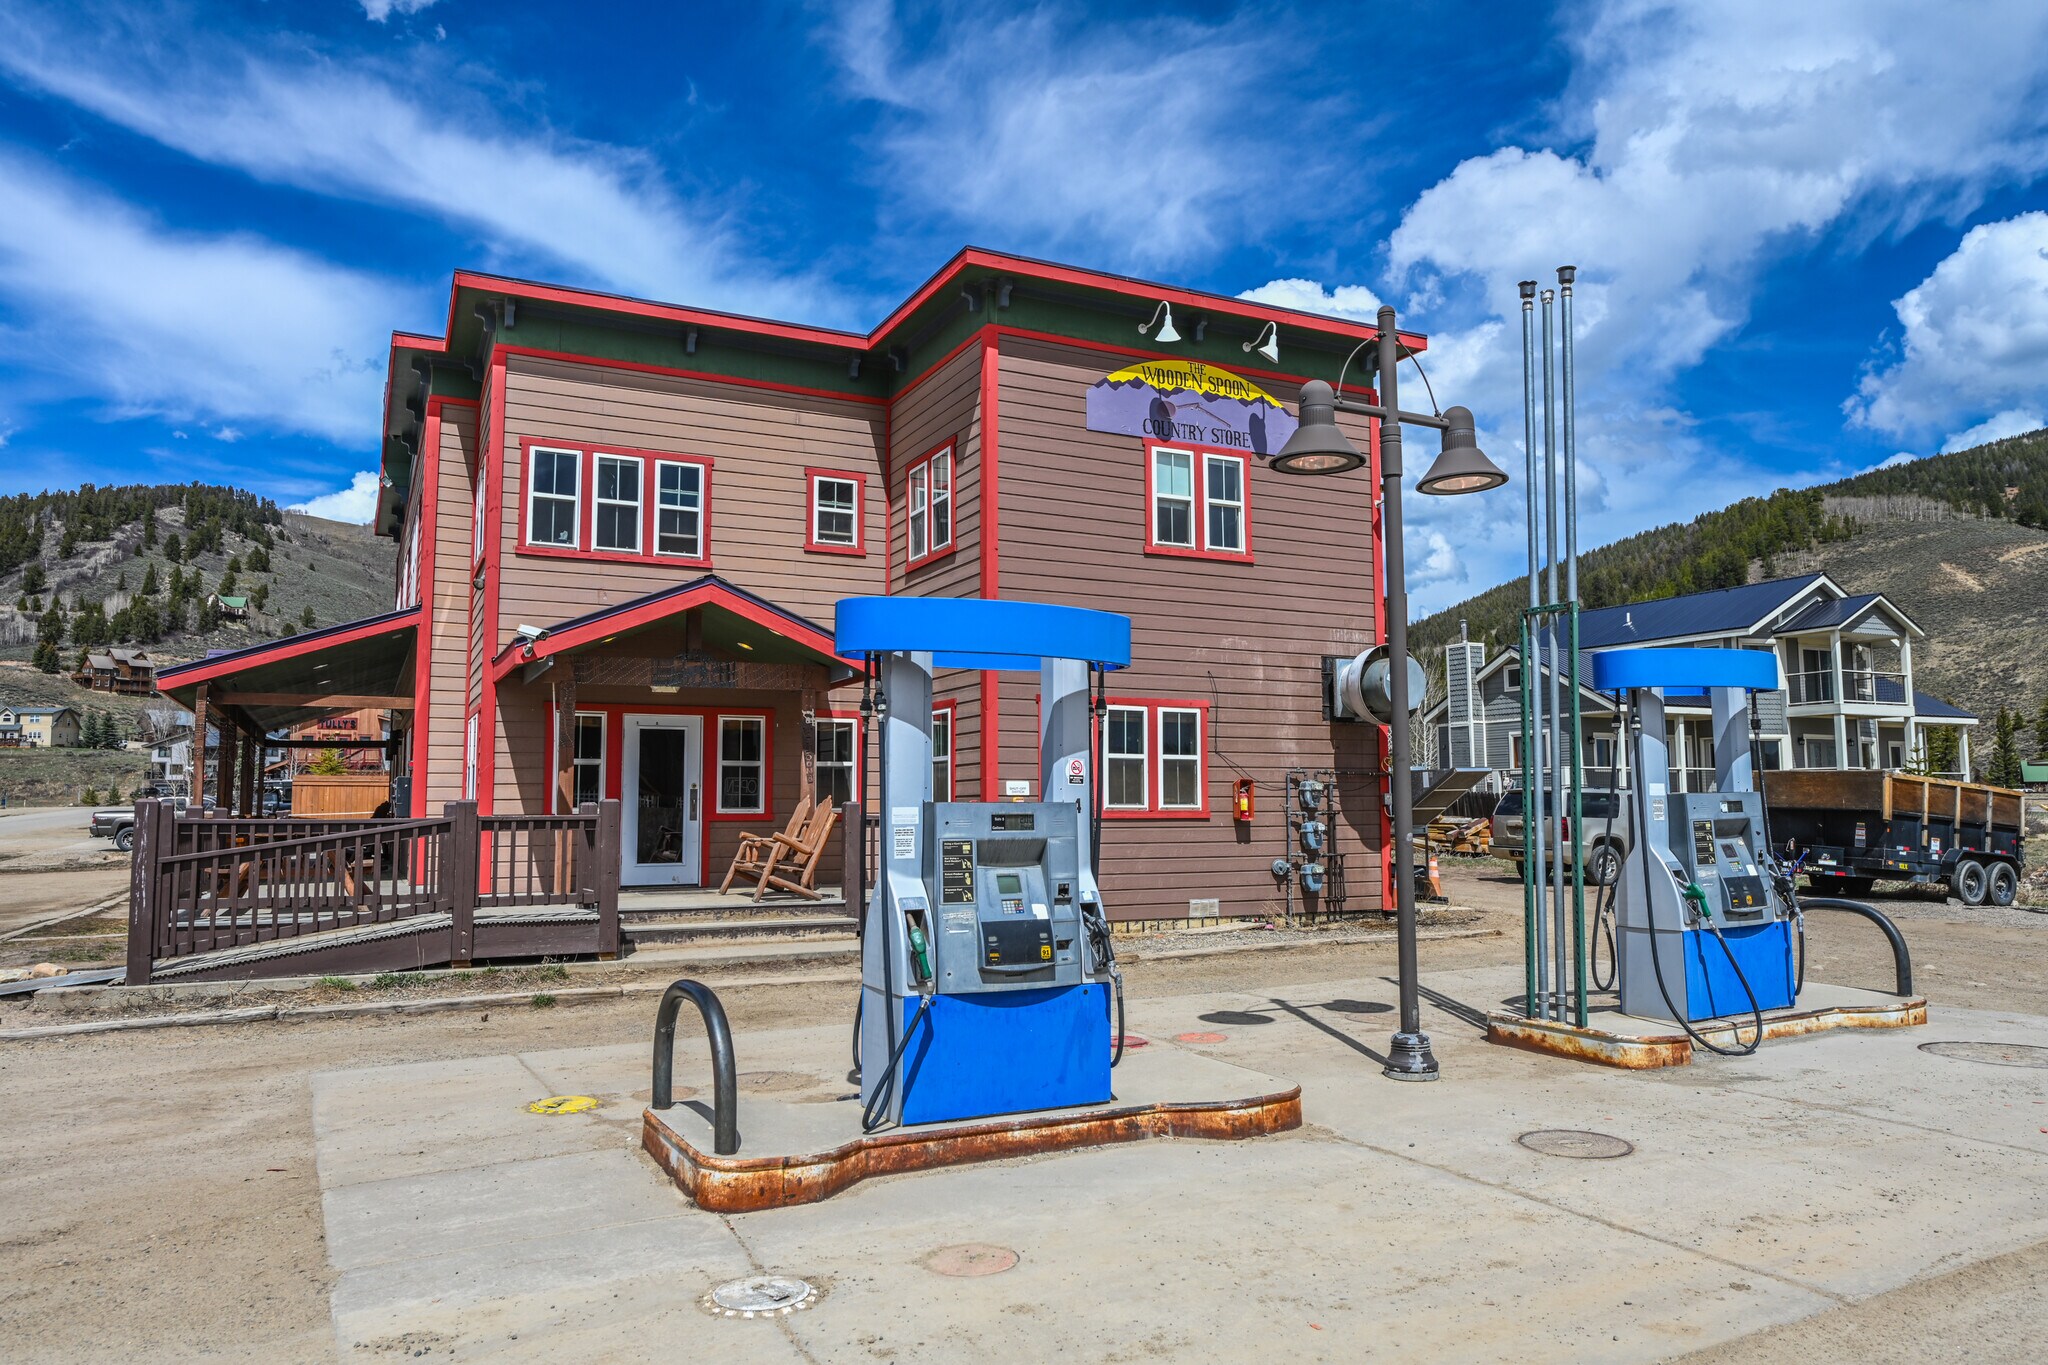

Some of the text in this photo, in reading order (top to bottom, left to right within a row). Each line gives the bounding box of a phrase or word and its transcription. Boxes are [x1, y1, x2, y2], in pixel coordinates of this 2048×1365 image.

[1187, 361, 1206, 375] THE
[1141, 366, 1250, 397] WOODEN SPOON
[1142, 418, 1251, 448] COUNTRY STORE
[320, 720, 356, 729] TULLY'S
